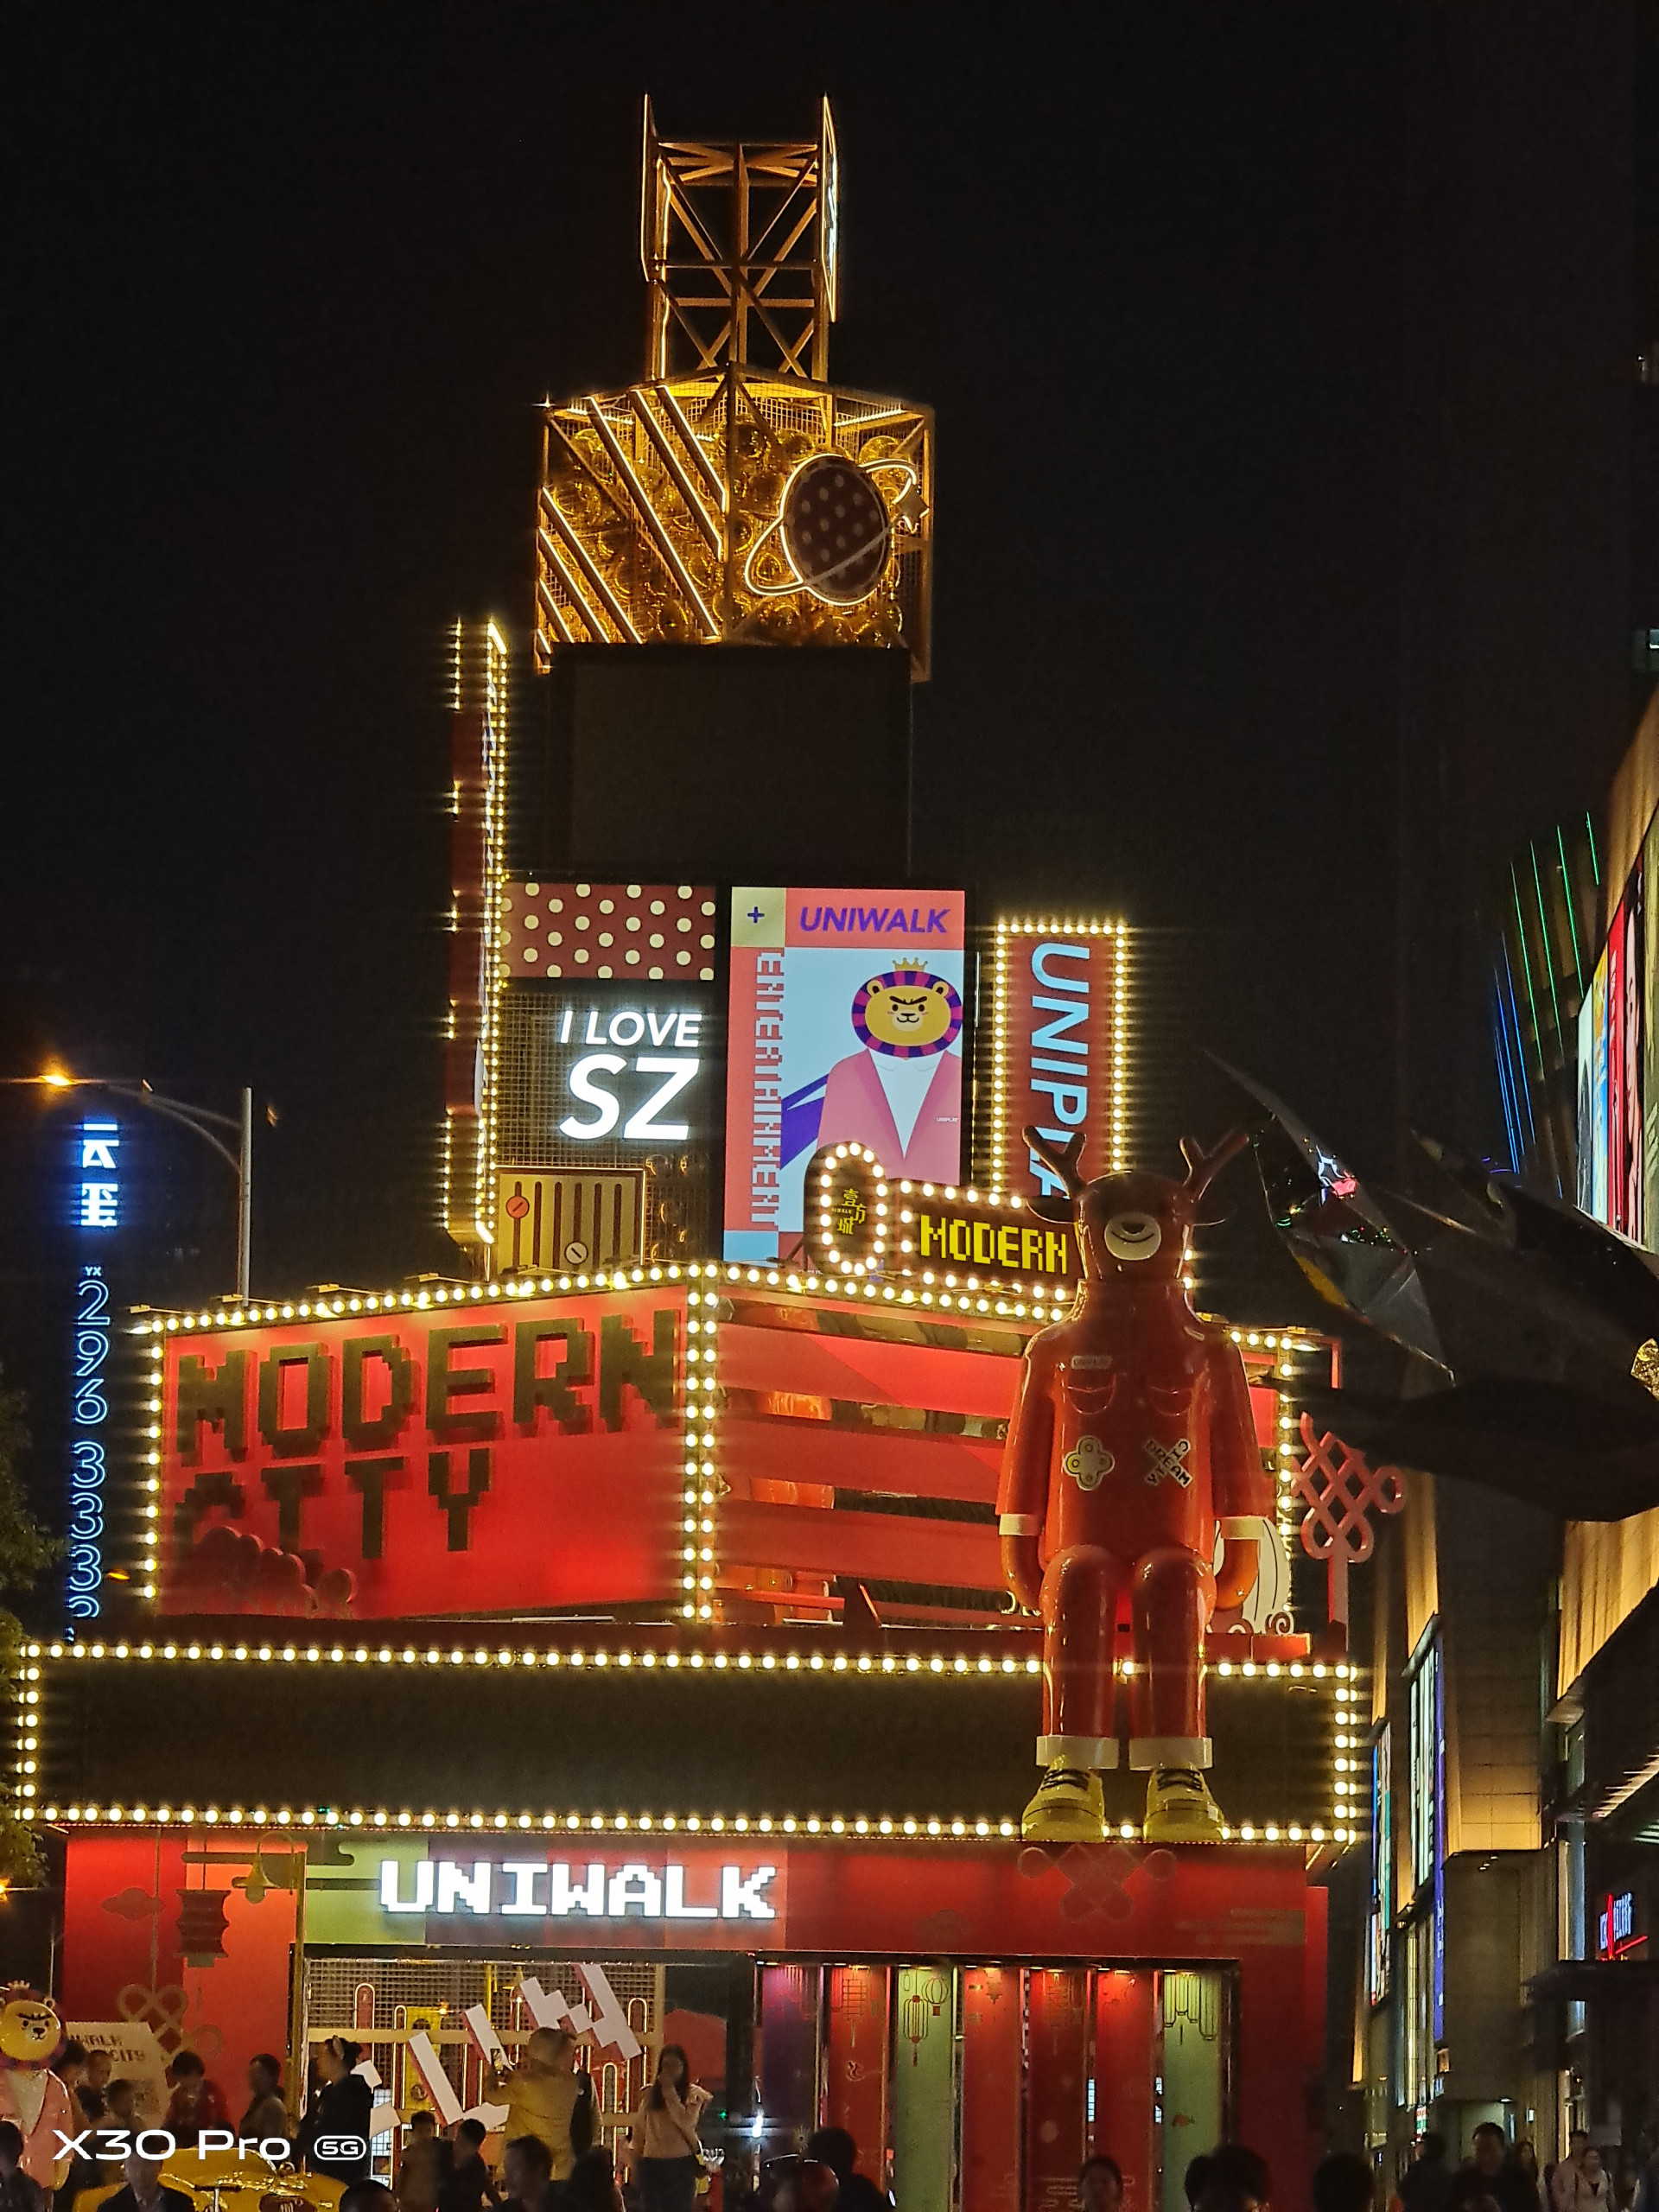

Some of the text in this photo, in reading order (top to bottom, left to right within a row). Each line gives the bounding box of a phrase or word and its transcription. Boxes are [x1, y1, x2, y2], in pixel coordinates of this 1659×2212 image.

[799, 906, 951, 934] UNIWALK
[560, 1010, 702, 1048] I LOVE
[559, 1053, 700, 1141] SZ
[752, 951, 784, 1225] ENTERTAINMENT
[85, 1266, 102, 1277] YX
[920, 1214, 1067, 1274] MODERN
[176, 1309, 681, 1463] MODERN
[380, 1860, 777, 1918] UNIWALK
